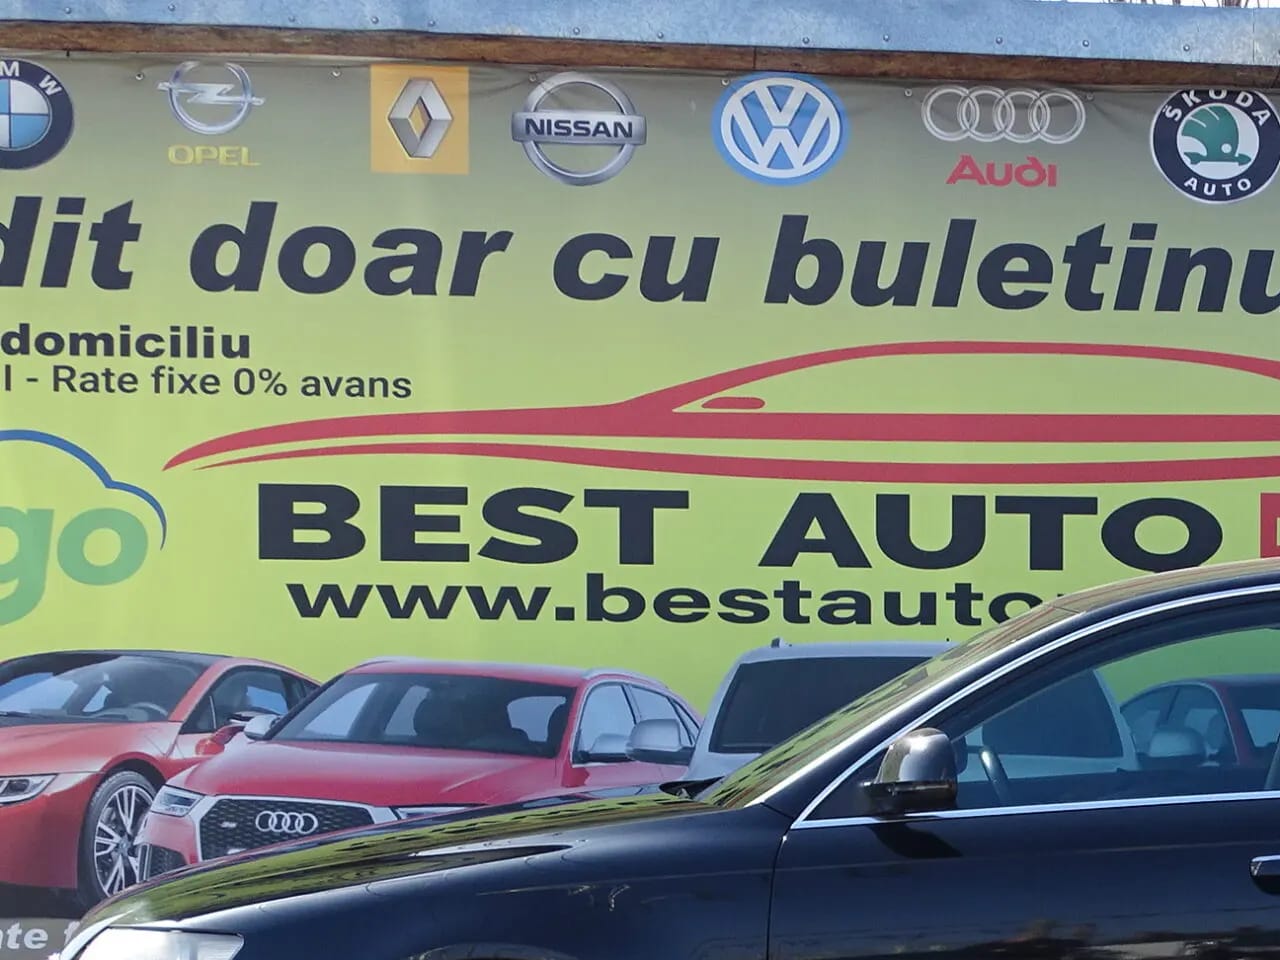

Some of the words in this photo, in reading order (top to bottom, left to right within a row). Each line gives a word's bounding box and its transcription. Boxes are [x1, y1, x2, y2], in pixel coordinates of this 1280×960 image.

[525, 118, 634, 139] NISSAN
[167, 144, 260, 167] OPEL
[946, 154, 1058, 188] Audi
[1184, 177, 1251, 196] AUTO
[189, 200, 514, 297] doar
[552, 229, 720, 303] cu
[0, 323, 251, 358] domiciliu
[53, 364, 139, 393] Rate
[151, 364, 221, 395] fixe
[233, 367, 288, 396] 0%
[301, 374, 412, 398] avans
[258, 483, 690, 565] BEST
[757, 491, 1223, 573] AUTO
[286, 573, 1048, 626] www.bestauto
